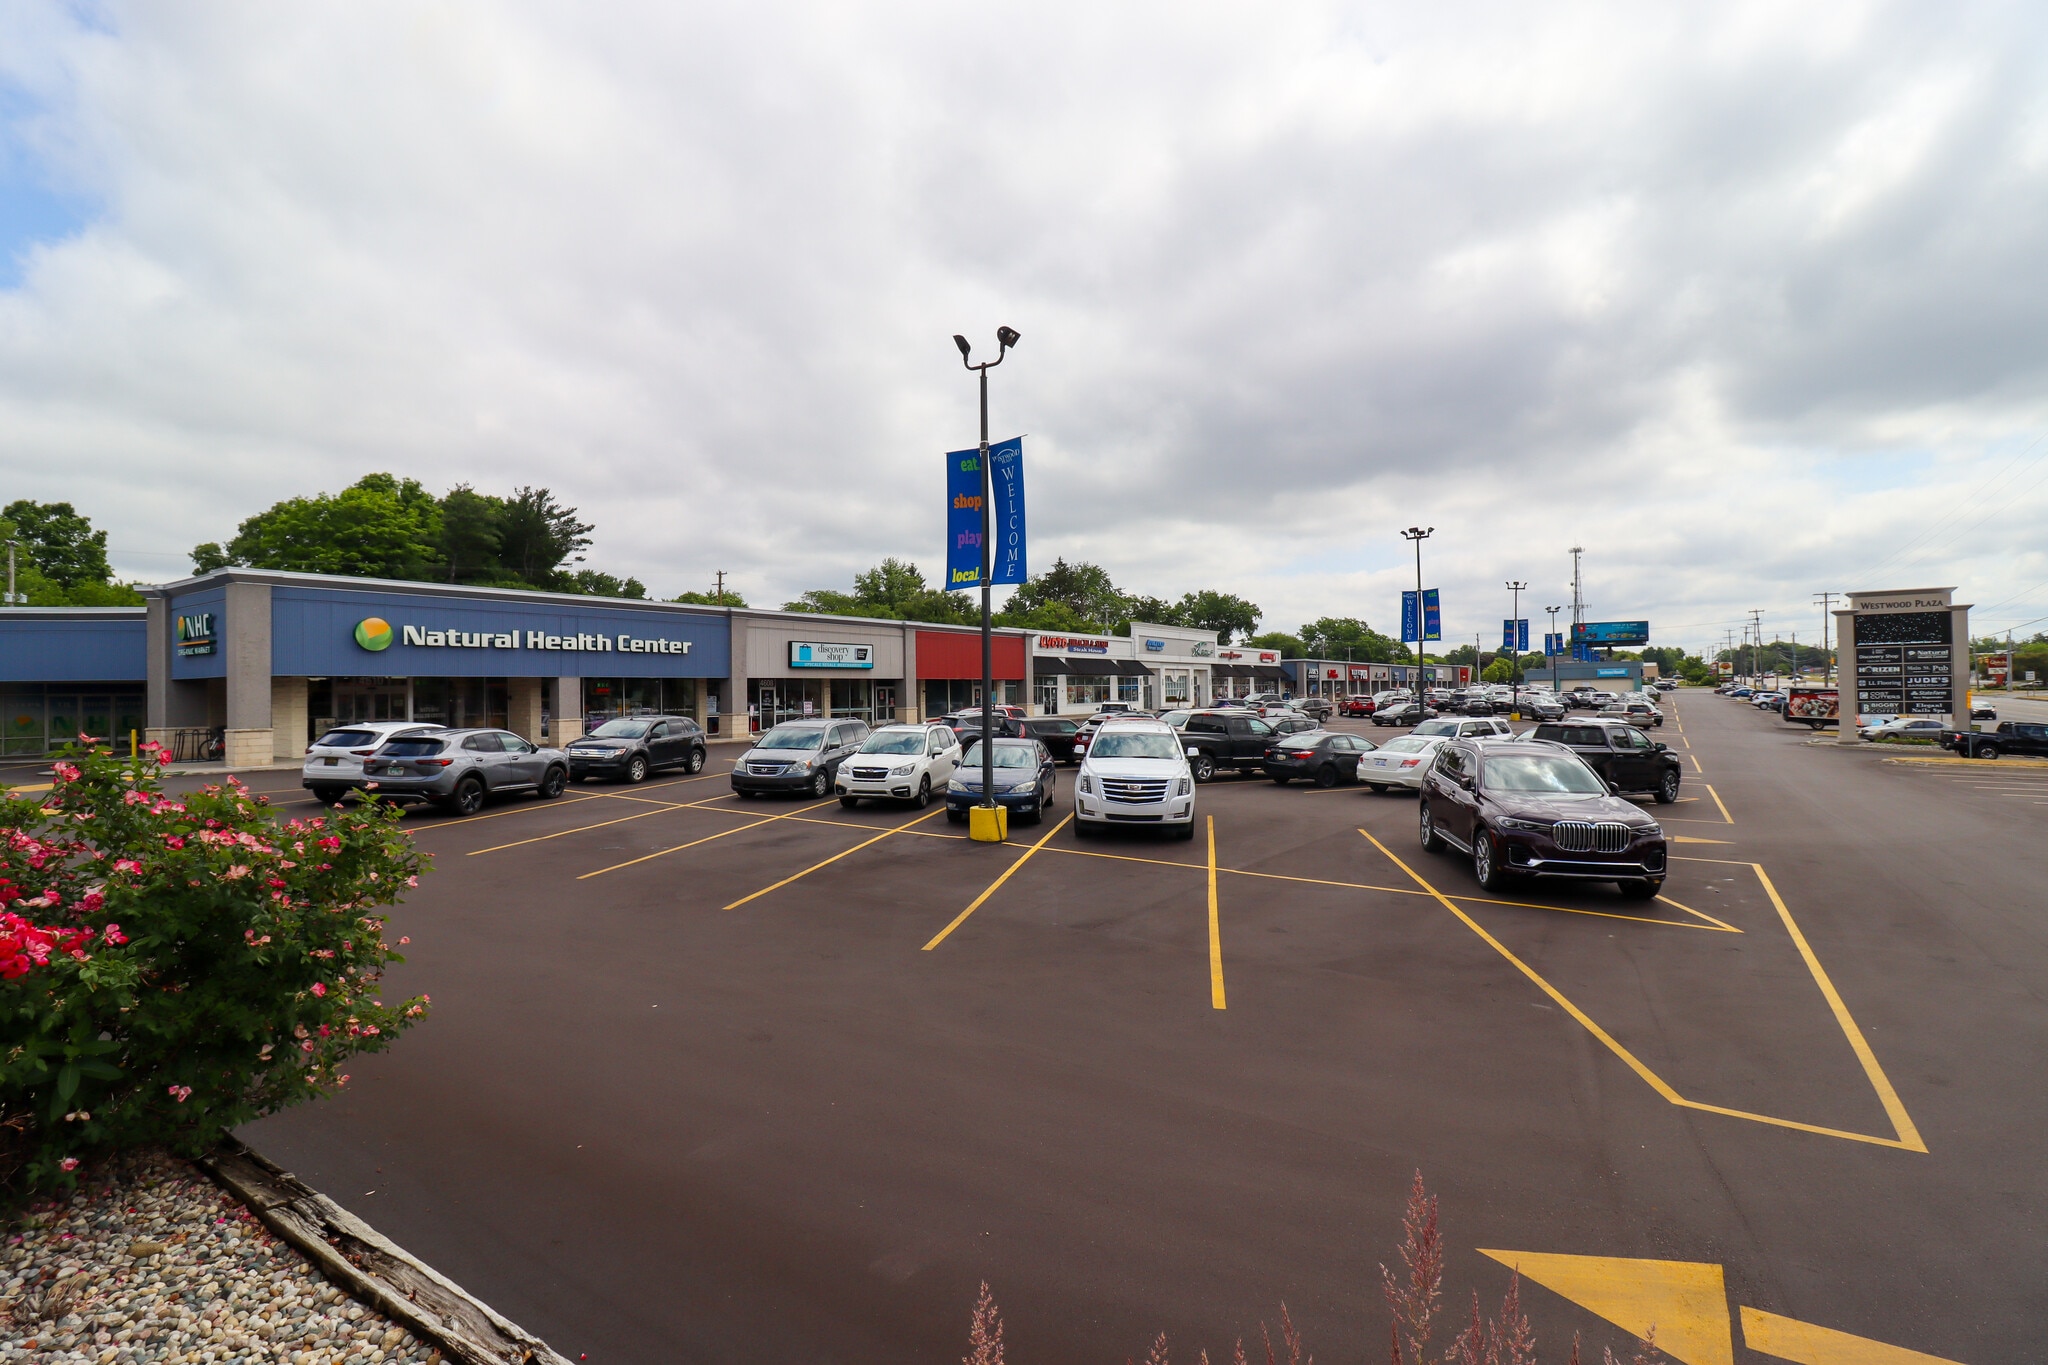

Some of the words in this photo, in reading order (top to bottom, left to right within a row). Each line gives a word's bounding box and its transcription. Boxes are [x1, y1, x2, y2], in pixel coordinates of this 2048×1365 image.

[1001, 465, 1019, 577] WELCOME
[1861, 601, 1912, 610] WESTWOOD
[1915, 599, 1943, 608] PLAZA
[185, 613, 211, 639] NHC
[403, 624, 520, 649] Natural
[527, 630, 612, 652] Health
[617, 634, 692, 654] Center
[817, 643, 850, 656] discovery
[826, 651, 844, 663] shop
[1932, 664, 1949, 672] Pub
[1907, 676, 1949, 684] JUDE'S
